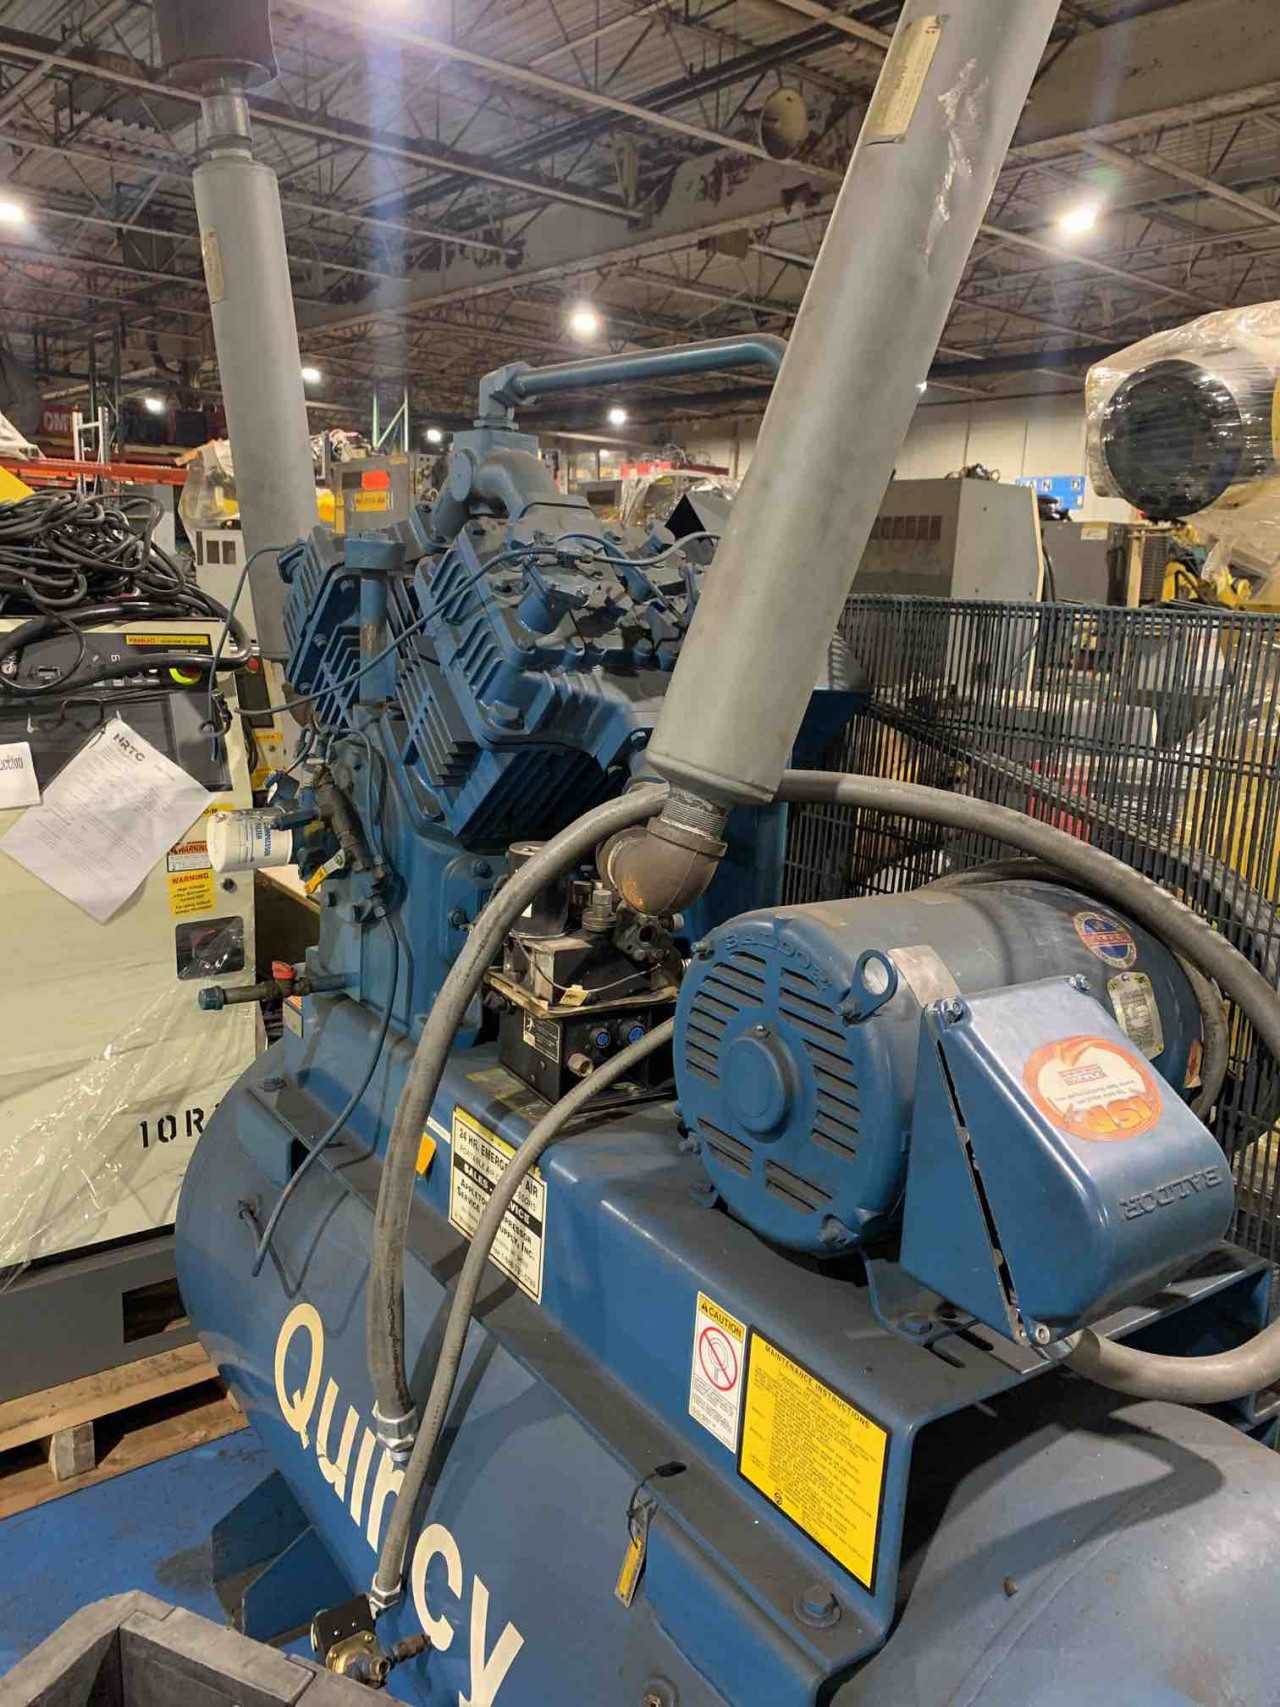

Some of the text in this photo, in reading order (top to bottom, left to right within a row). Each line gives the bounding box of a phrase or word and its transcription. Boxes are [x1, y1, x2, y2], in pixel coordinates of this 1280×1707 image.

[139, 1108, 205, 1149] 10R
[525, 1180, 538, 1199] AIR
[707, 1306, 742, 1339] CAUTION
